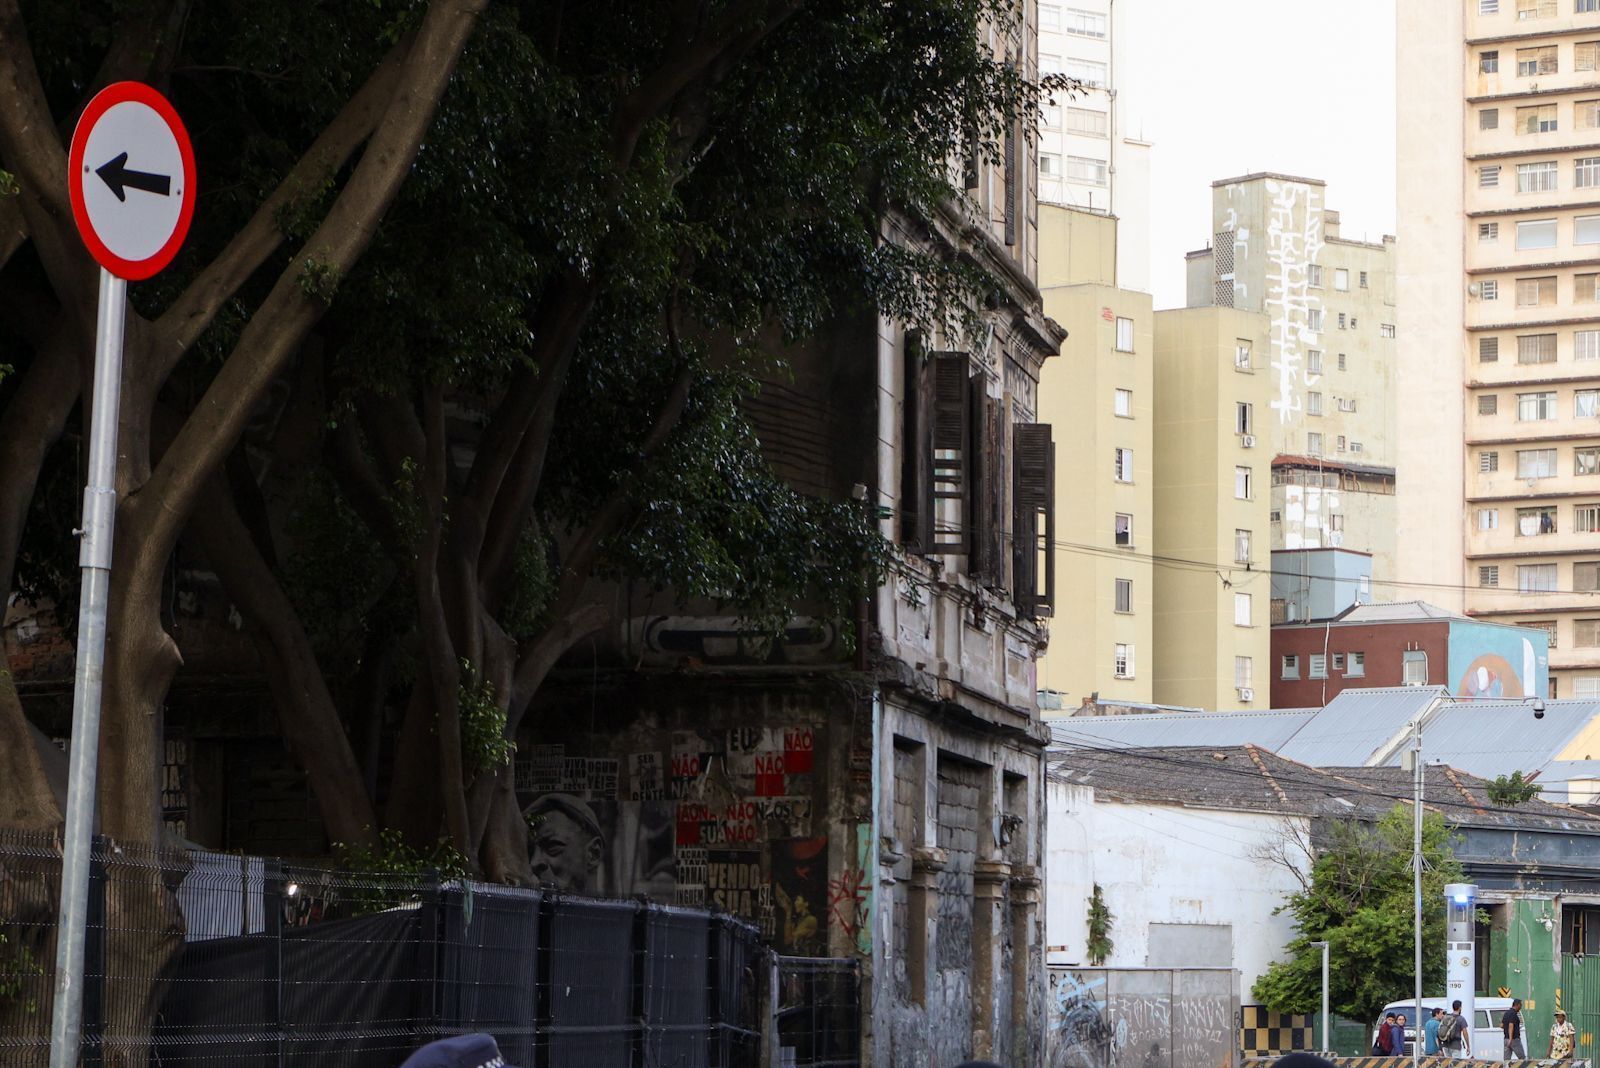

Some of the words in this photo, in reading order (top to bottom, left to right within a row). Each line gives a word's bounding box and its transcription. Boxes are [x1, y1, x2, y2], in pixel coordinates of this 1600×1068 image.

[731, 728, 752, 751] EU
[785, 728, 813, 751] NÃO
[672, 752, 700, 776] NÃO
[756, 752, 784, 773] NÃO
[726, 820, 755, 841] NÃO
[708, 863, 760, 889] VENDO
[713, 889, 752, 917] SUA
